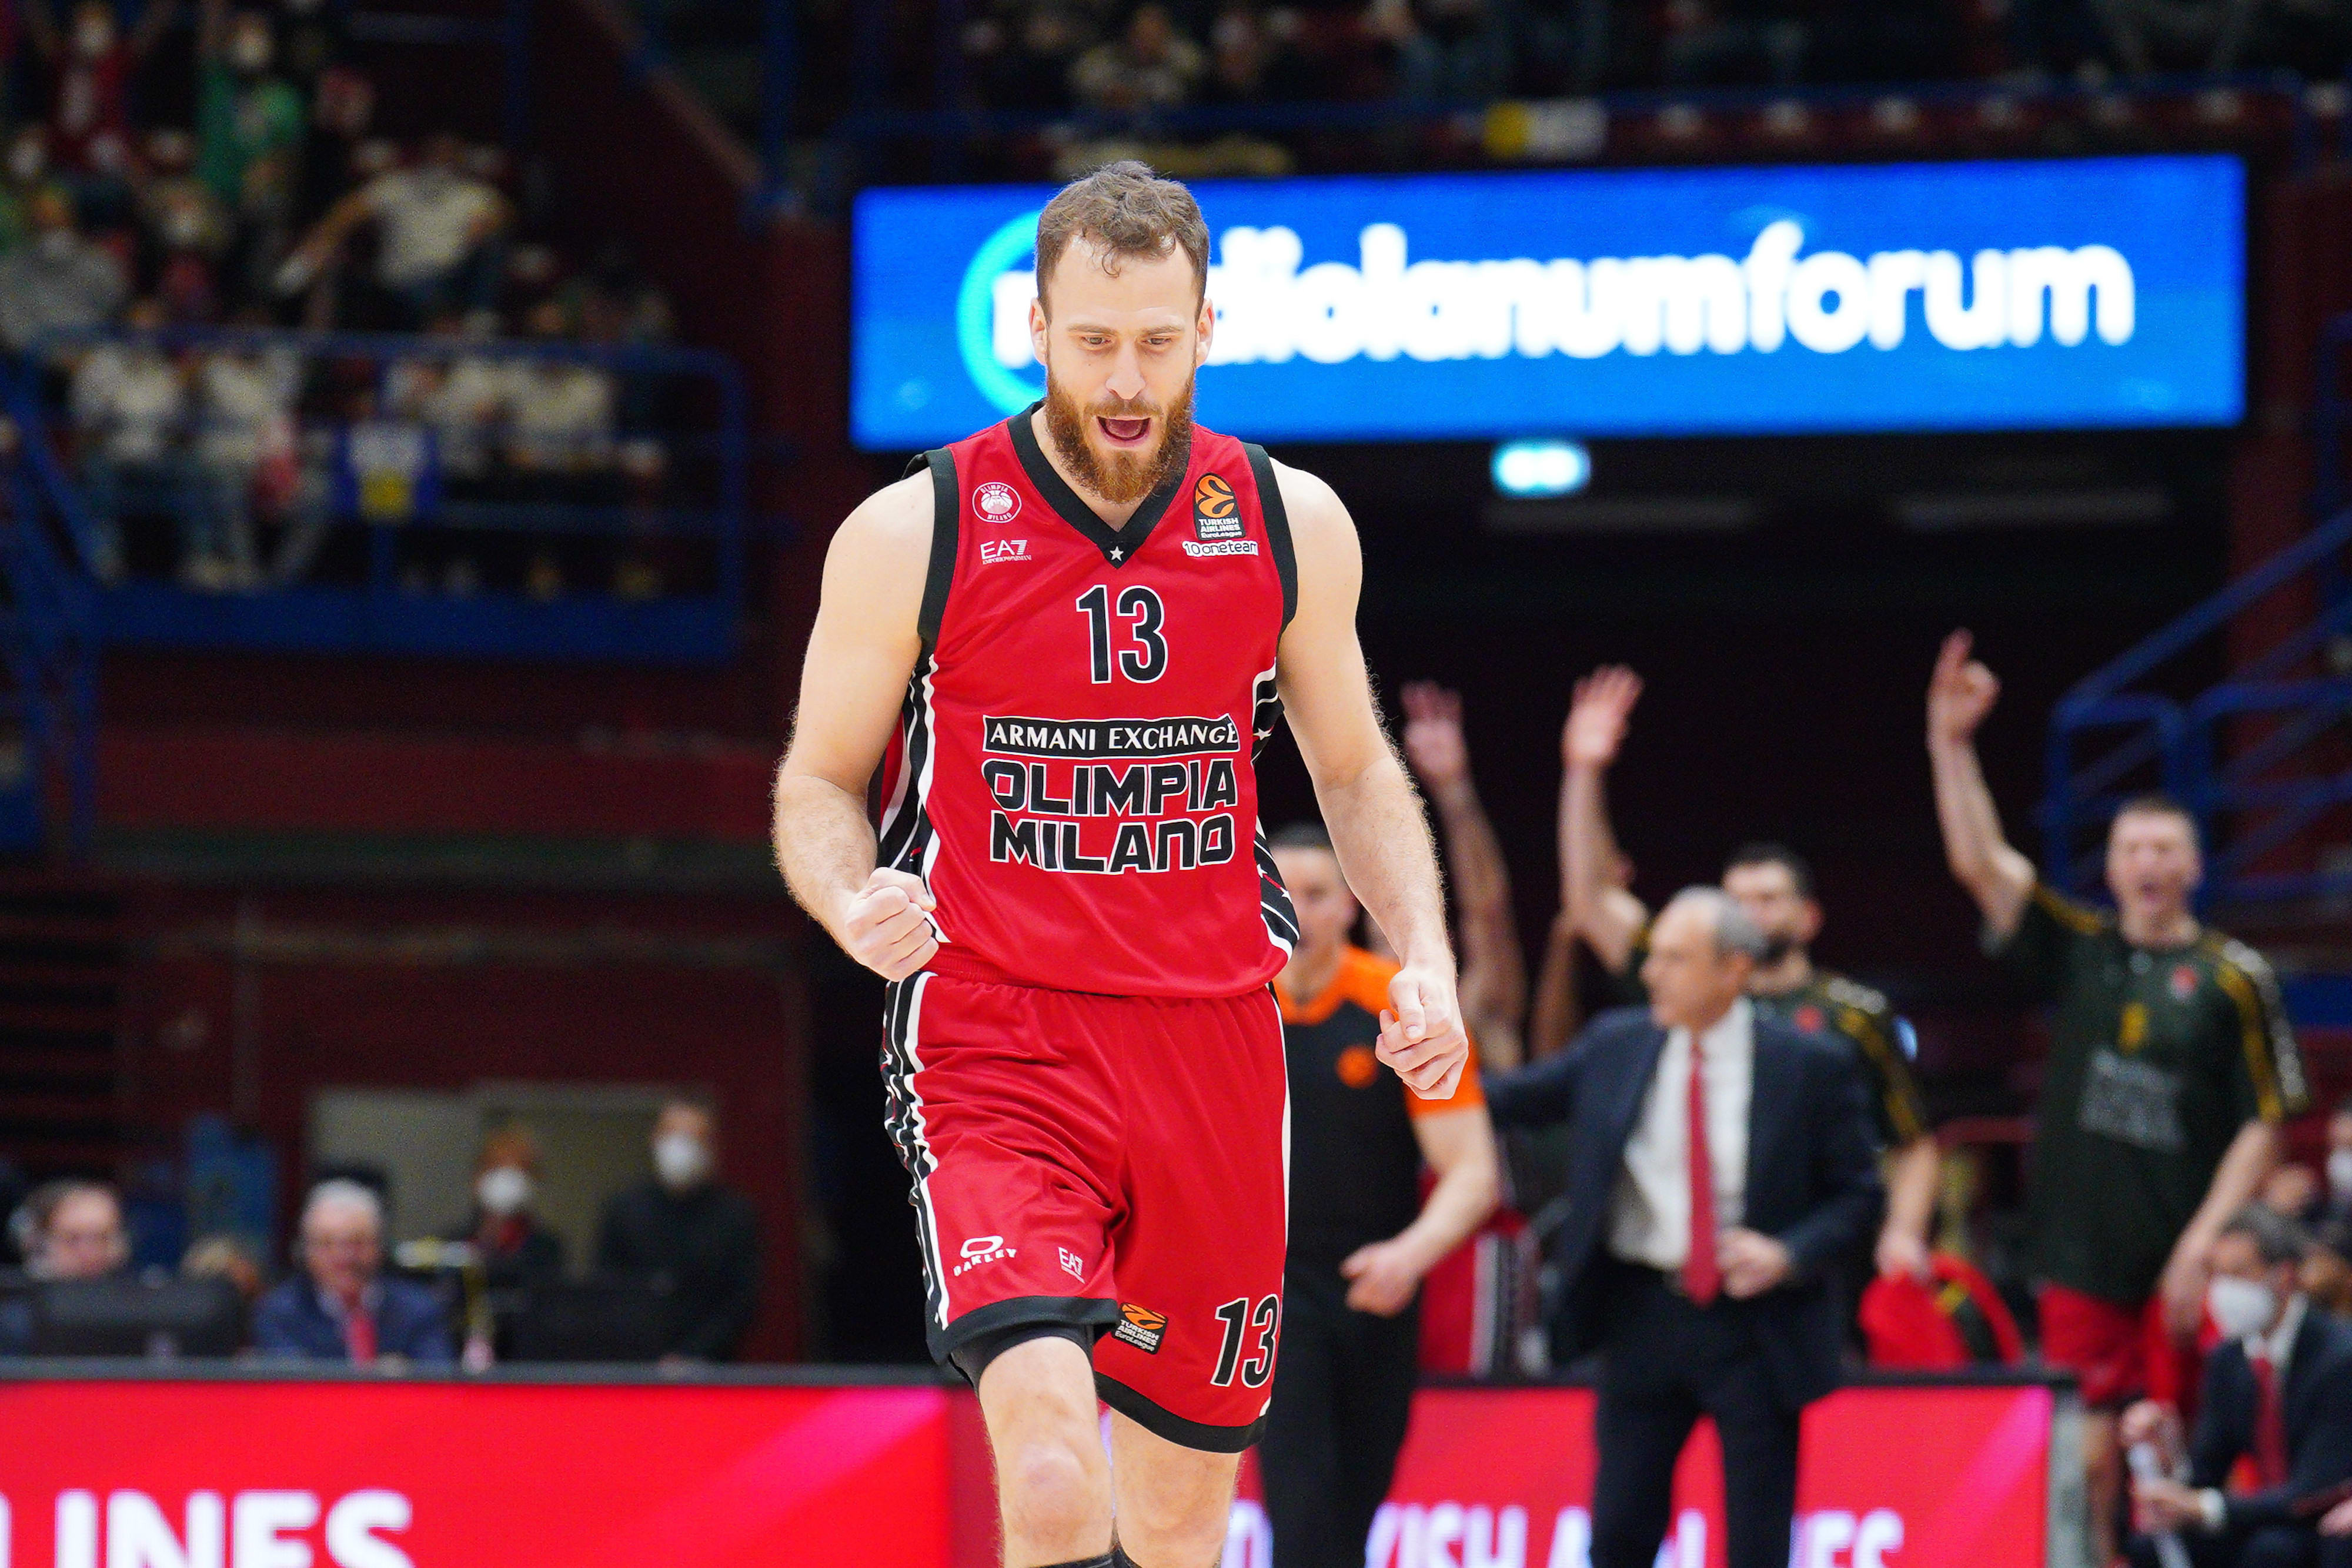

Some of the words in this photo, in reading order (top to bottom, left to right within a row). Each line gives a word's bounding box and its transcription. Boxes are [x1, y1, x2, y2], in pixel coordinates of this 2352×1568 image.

[980, 484, 1008, 493] OLIMPIA
[987, 512, 1013, 520] MILANO
[1198, 517, 1239, 526] TURKISH
[1200, 524, 1241, 533] AIRLINES
[980, 539, 1028, 560] EA7
[1075, 584, 1169, 684] 13
[990, 723, 1096, 751] ARMANI
[1108, 723, 1239, 750] EXCHANGE
[981, 758, 1238, 817] OLIMPIA
[990, 809, 1236, 875] MILANO
[953, 1248, 1017, 1276] OAKLEY
[1058, 1246, 1084, 1276] EA7
[1117, 1325, 1157, 1346] AIRLINES
[1120, 1319, 1160, 1341] TURKISH
[1210, 1293, 1280, 1389] 13
